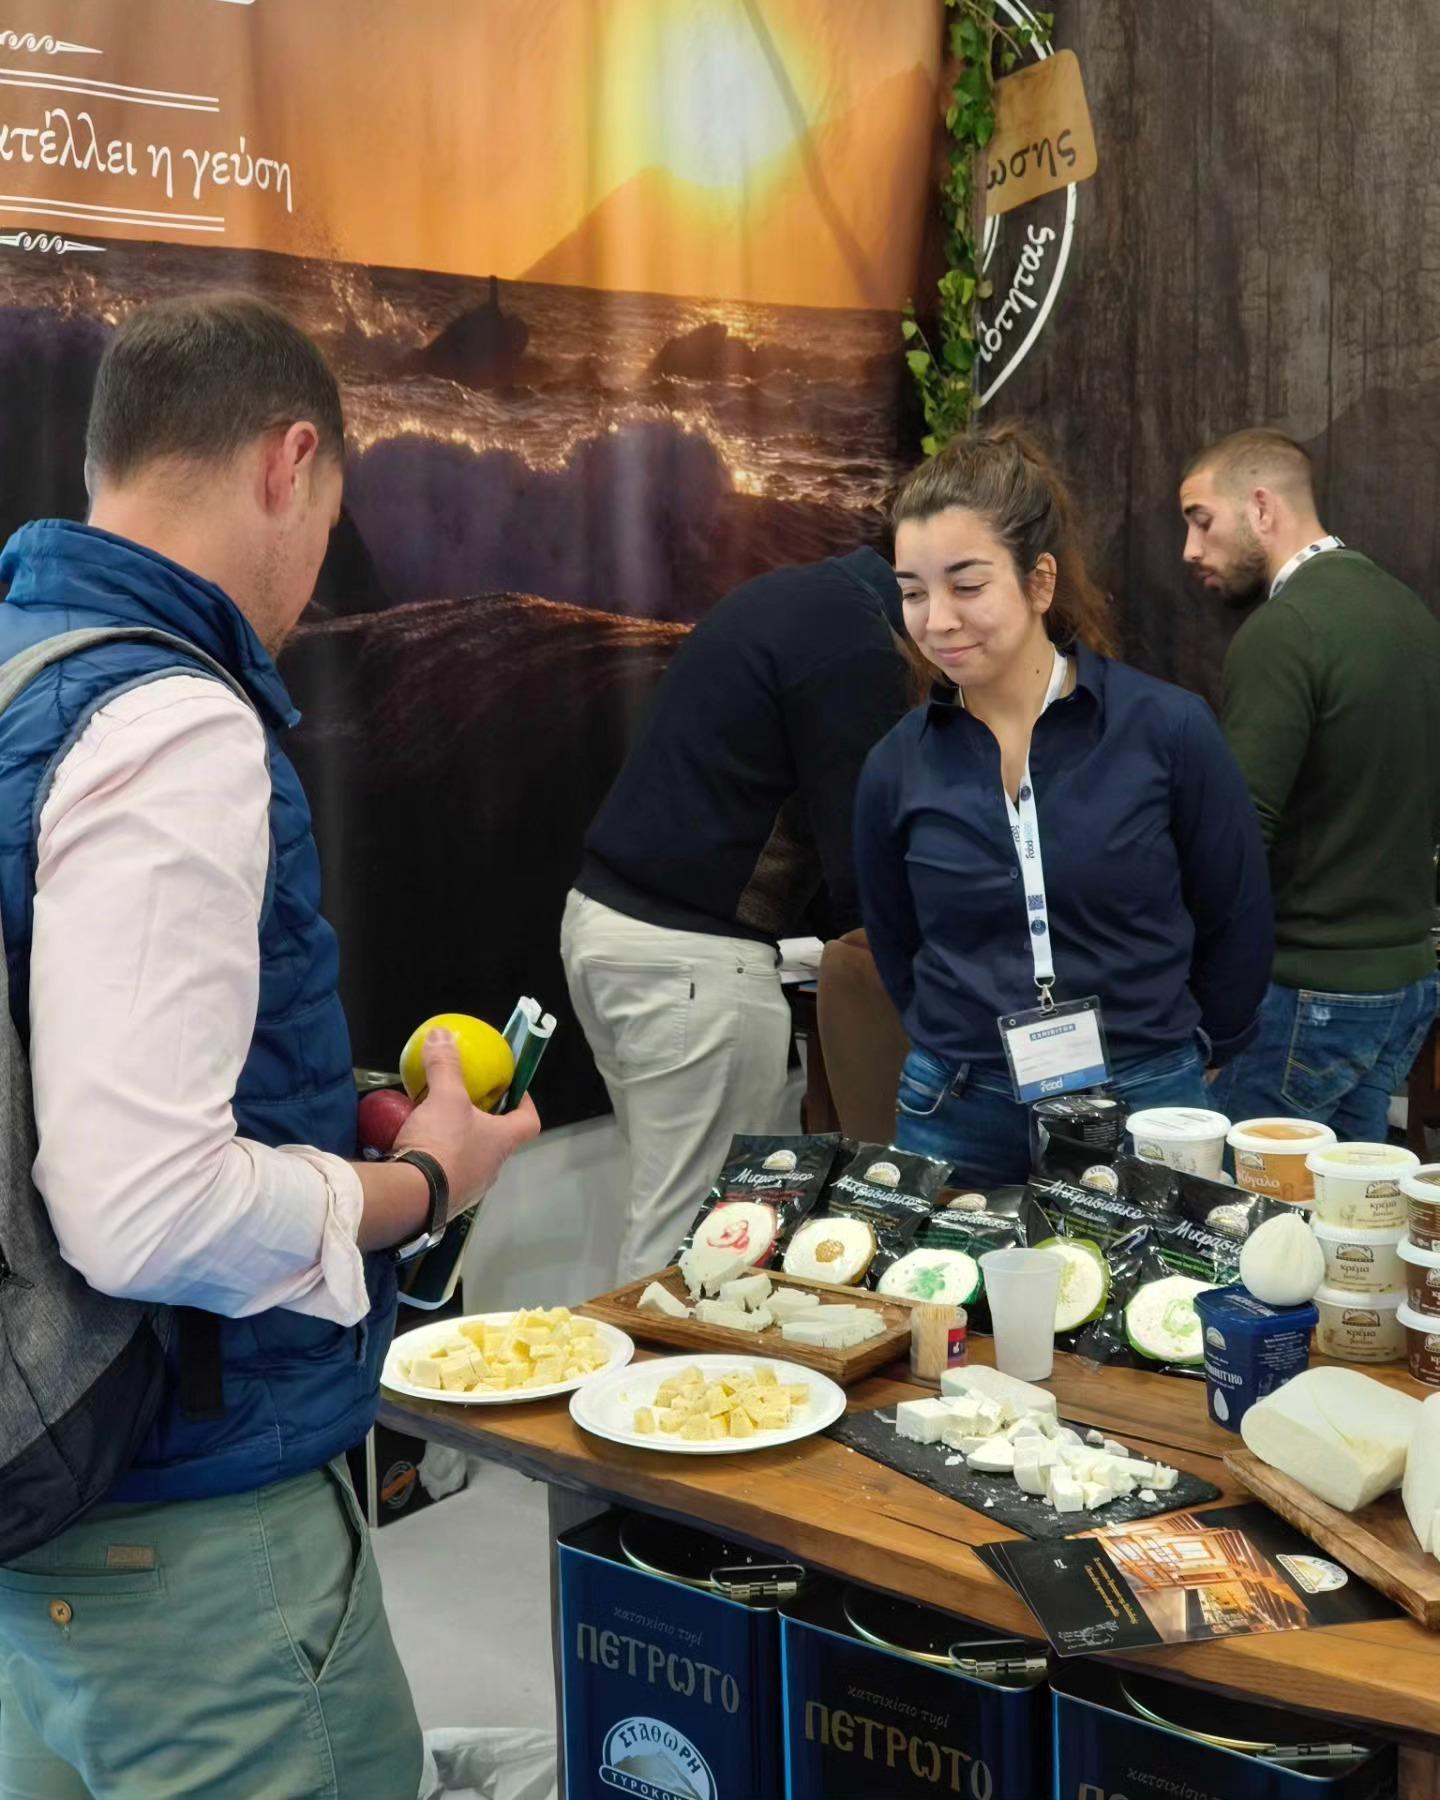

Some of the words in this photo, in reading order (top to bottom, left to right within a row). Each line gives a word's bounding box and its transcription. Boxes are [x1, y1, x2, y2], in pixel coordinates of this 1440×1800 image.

[147, 144, 174, 199] η
[183, 136, 293, 214] γεύση
[617, 1722, 702, 1774] ΣΤΑΘΩΡΗ
